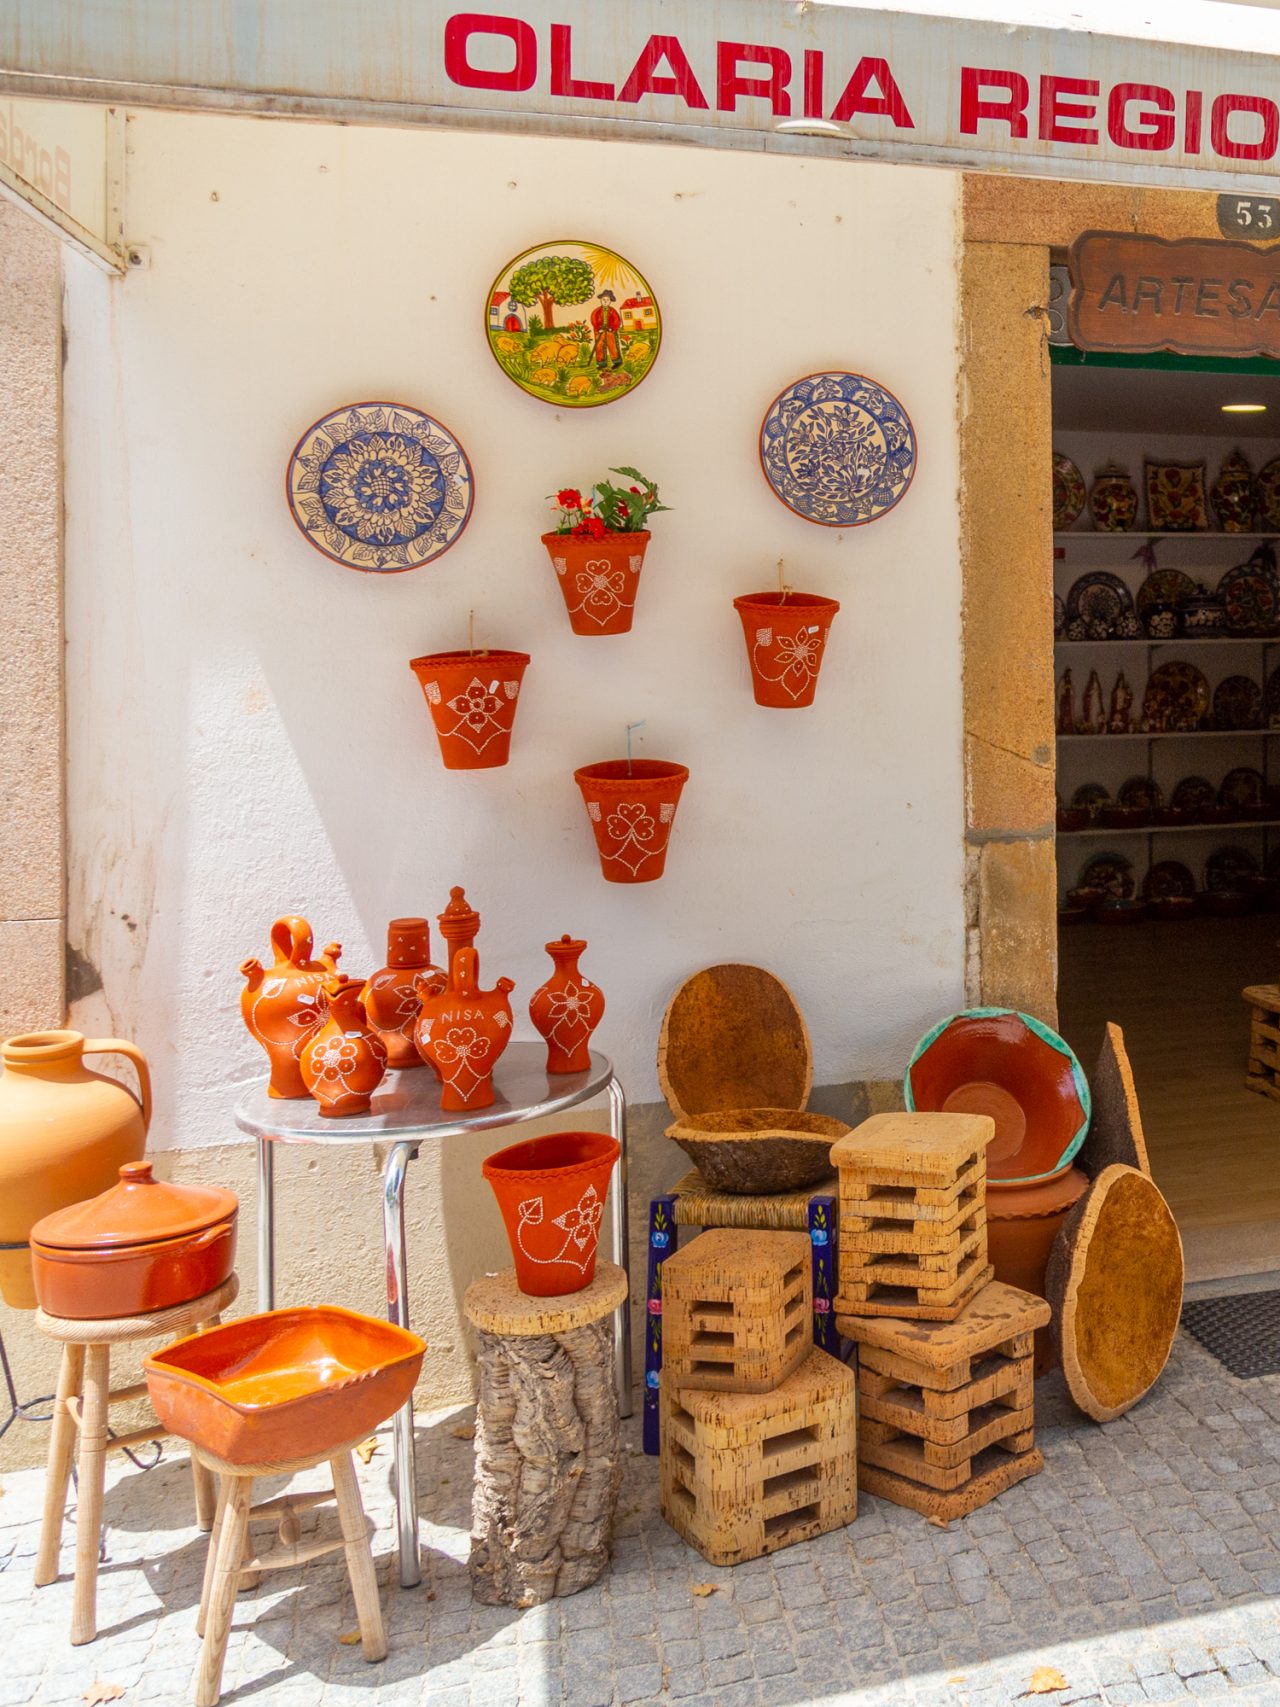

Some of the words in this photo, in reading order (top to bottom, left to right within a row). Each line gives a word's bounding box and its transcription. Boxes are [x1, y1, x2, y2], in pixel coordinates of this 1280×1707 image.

[443, 13, 916, 129] OLARIA
[1236, 201, 1272, 228] 53
[295, 972, 336, 987] NISA
[441, 1009, 485, 1024] NISA
